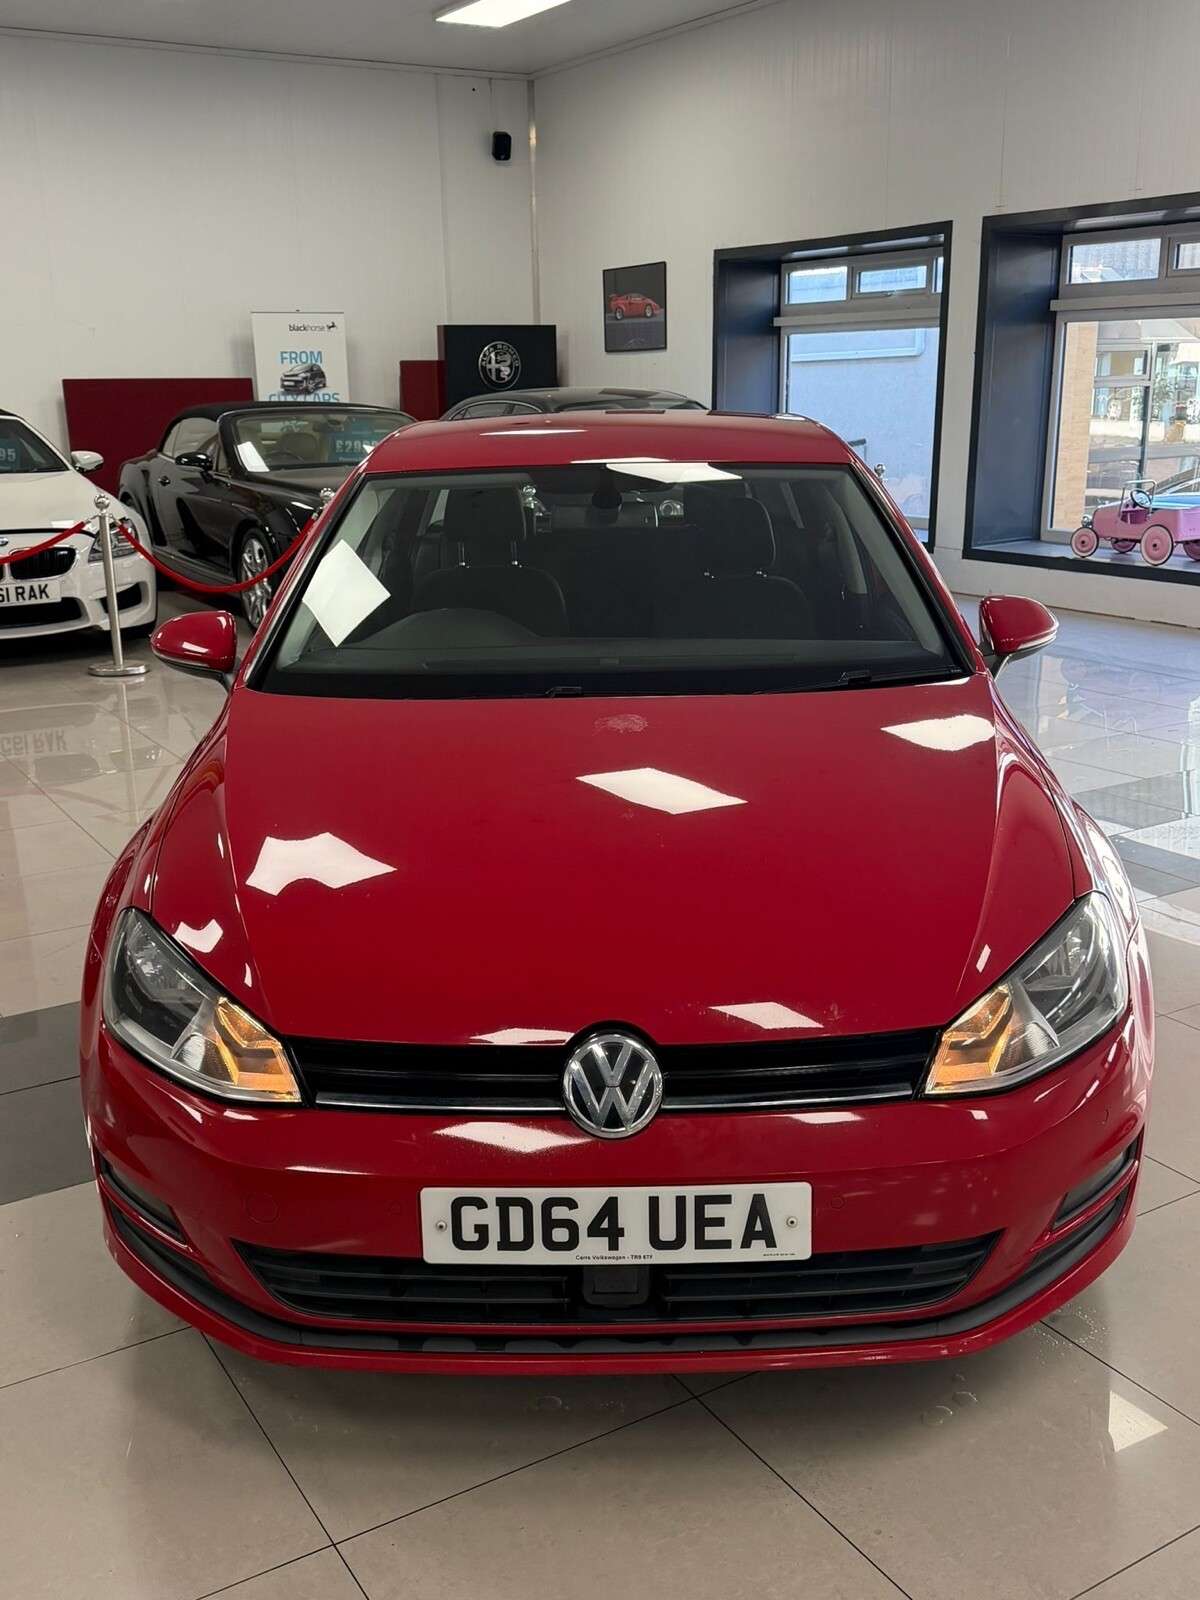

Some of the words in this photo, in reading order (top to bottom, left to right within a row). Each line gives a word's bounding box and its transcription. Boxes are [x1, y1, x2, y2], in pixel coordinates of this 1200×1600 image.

[288, 323, 326, 332] blackhorse
[279, 350, 323, 365] FROM
[15, 583, 50, 602] RAK
[450, 1195, 625, 1252] GD64
[648, 1193, 778, 1251] UEA
